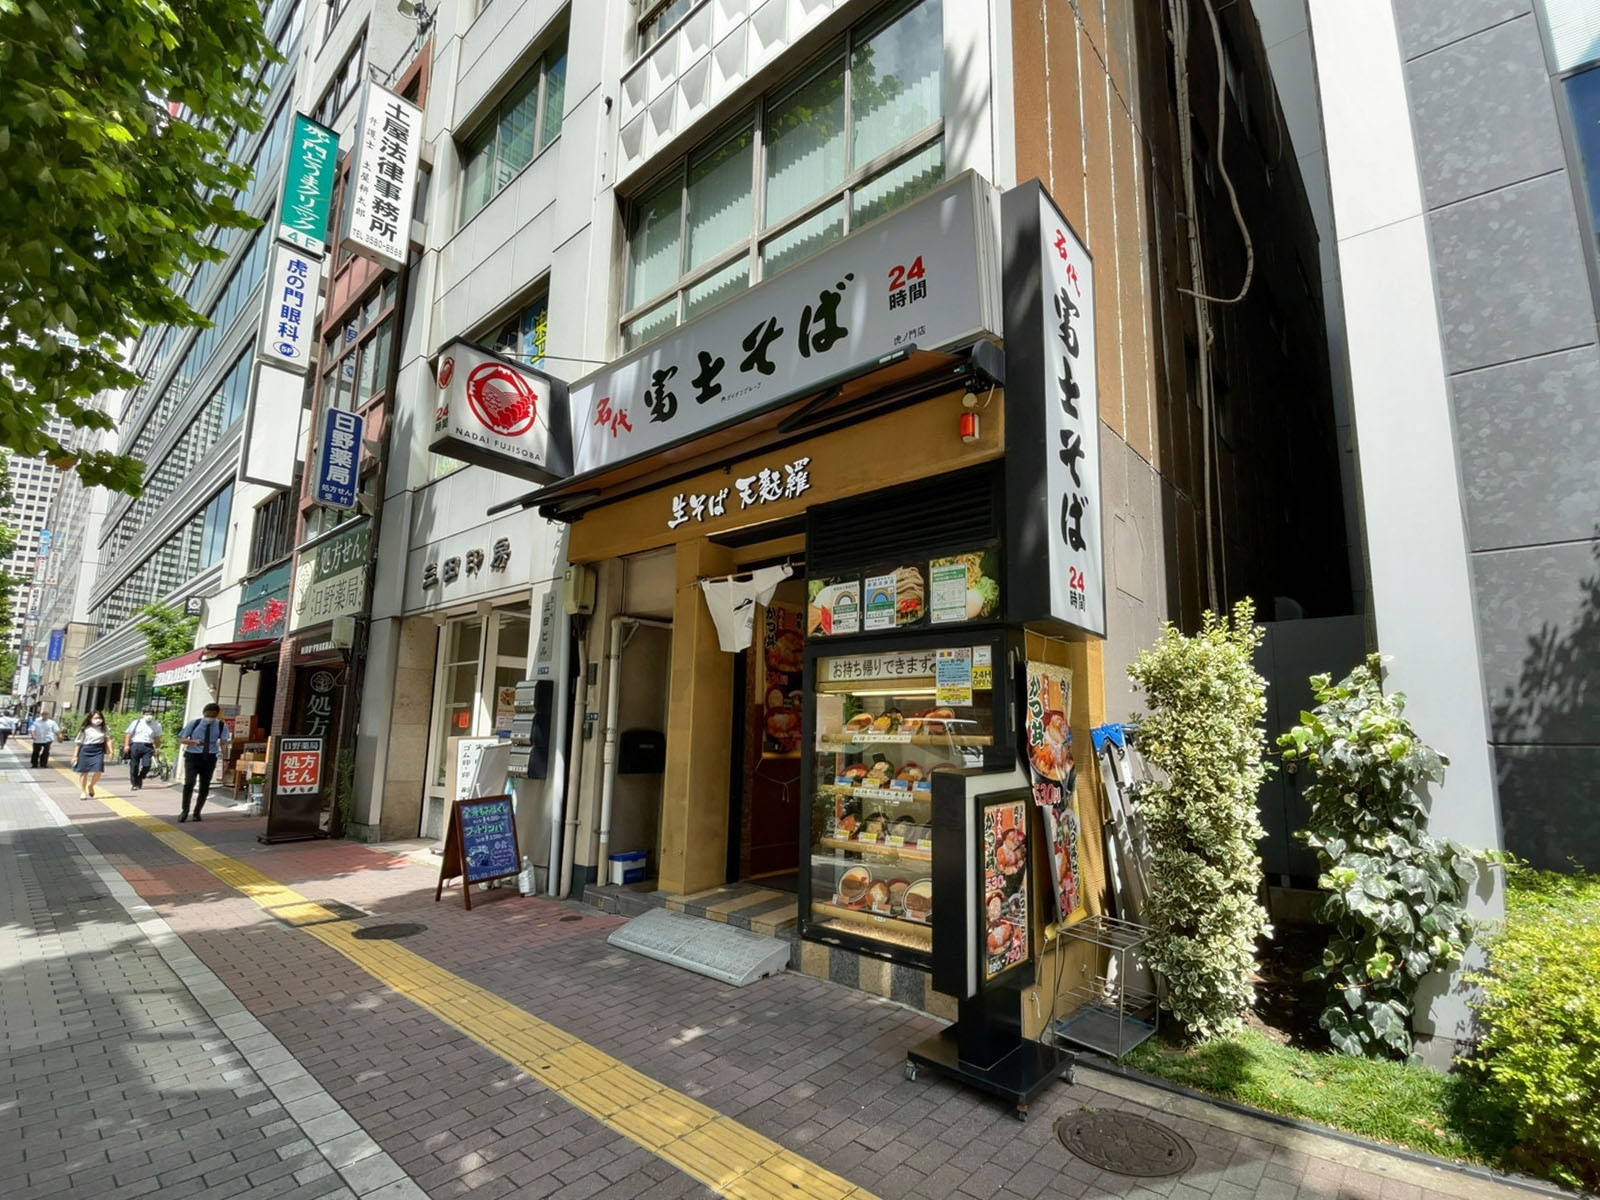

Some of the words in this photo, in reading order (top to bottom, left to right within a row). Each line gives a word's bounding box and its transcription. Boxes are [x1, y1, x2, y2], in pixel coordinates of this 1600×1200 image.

[369, 102, 411, 243] 土屋法律事務所
[287, 231, 317, 248] 4F
[888, 255, 926, 293] 24
[1055, 228, 1081, 298] 名代
[277, 258, 309, 342] 虎の門眼科
[888, 279, 928, 312] 時間
[893, 325, 926, 346] 虎ノ門店
[436, 404, 449, 422] 24
[593, 396, 633, 438] 名代
[326, 412, 355, 486] 日野薬局
[455, 426, 490, 444] NADAI
[494, 440, 541, 461] FUJISOBA
[1068, 566, 1085, 591] 24
[1069, 589, 1086, 613] 時間
[832, 656, 933, 679] お持ち帰りできます
[973, 670, 992, 679] 24H
[973, 679, 992, 687] OPEN
[306, 694, 331, 737] 処方
[283, 755, 317, 769] 処方
[282, 769, 315, 784] せん
